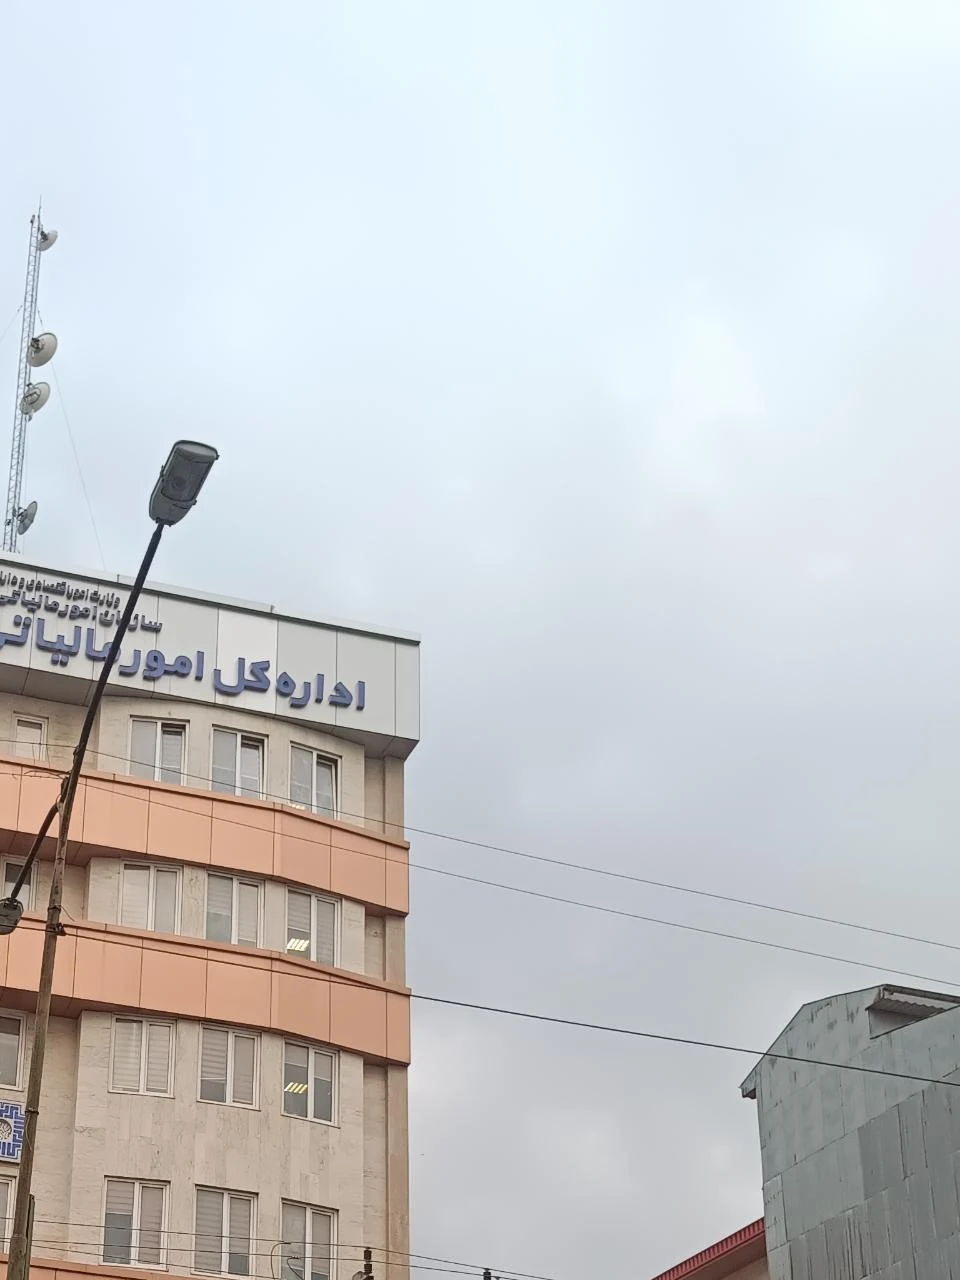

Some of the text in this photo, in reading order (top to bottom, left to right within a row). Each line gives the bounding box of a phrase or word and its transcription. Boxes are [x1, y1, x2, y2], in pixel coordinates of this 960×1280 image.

[58, 604, 98, 621] امور
[99, 610, 163, 633] سازان
[118, 648, 205, 682] امور
[213, 656, 272, 696] کل
[276, 671, 366, 711] اداره
